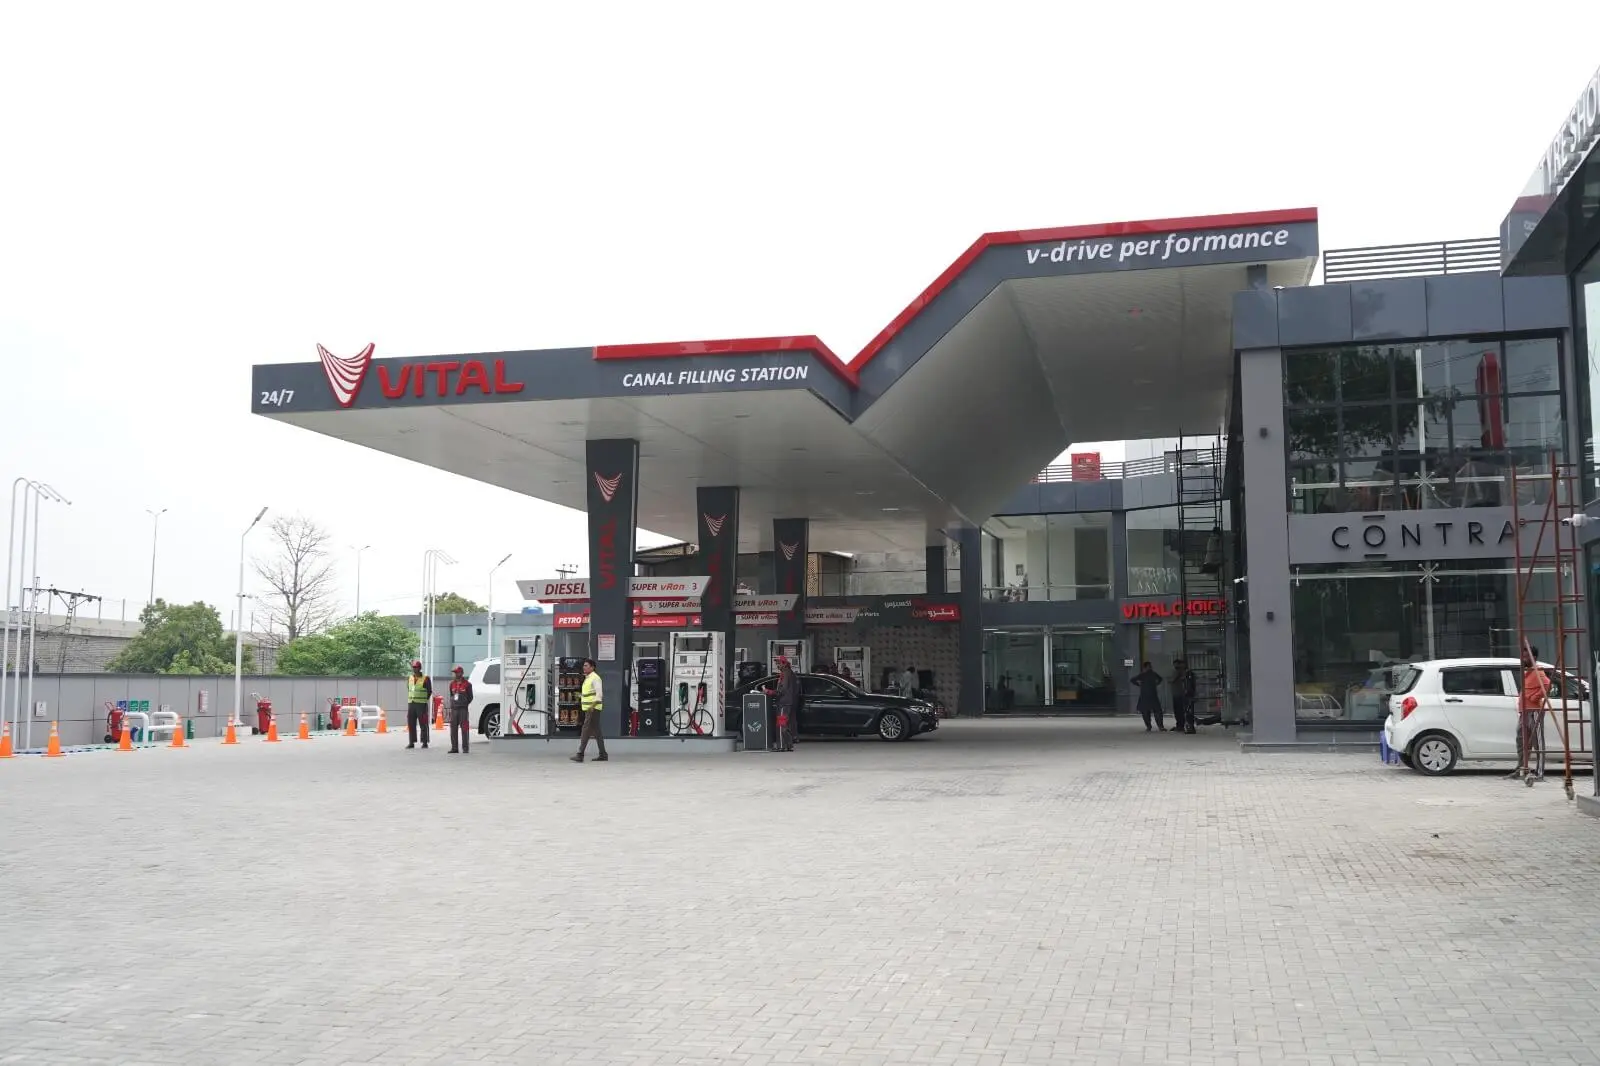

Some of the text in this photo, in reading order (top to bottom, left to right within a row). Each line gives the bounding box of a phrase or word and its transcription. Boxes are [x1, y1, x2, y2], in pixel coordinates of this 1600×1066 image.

[1026, 229, 1289, 264] v-drive performance
[376, 359, 525, 399] VITAL
[622, 366, 809, 388] CANAL FILLING STATION
[261, 389, 295, 407] 24/7
[544, 582, 587, 596] DIESEL
[631, 583, 658, 591] SUPER
[692, 582, 697, 591] 3
[658, 601, 680, 609] SUPER
[783, 599, 789, 607] 7
[1122, 601, 1171, 619] VITAL
